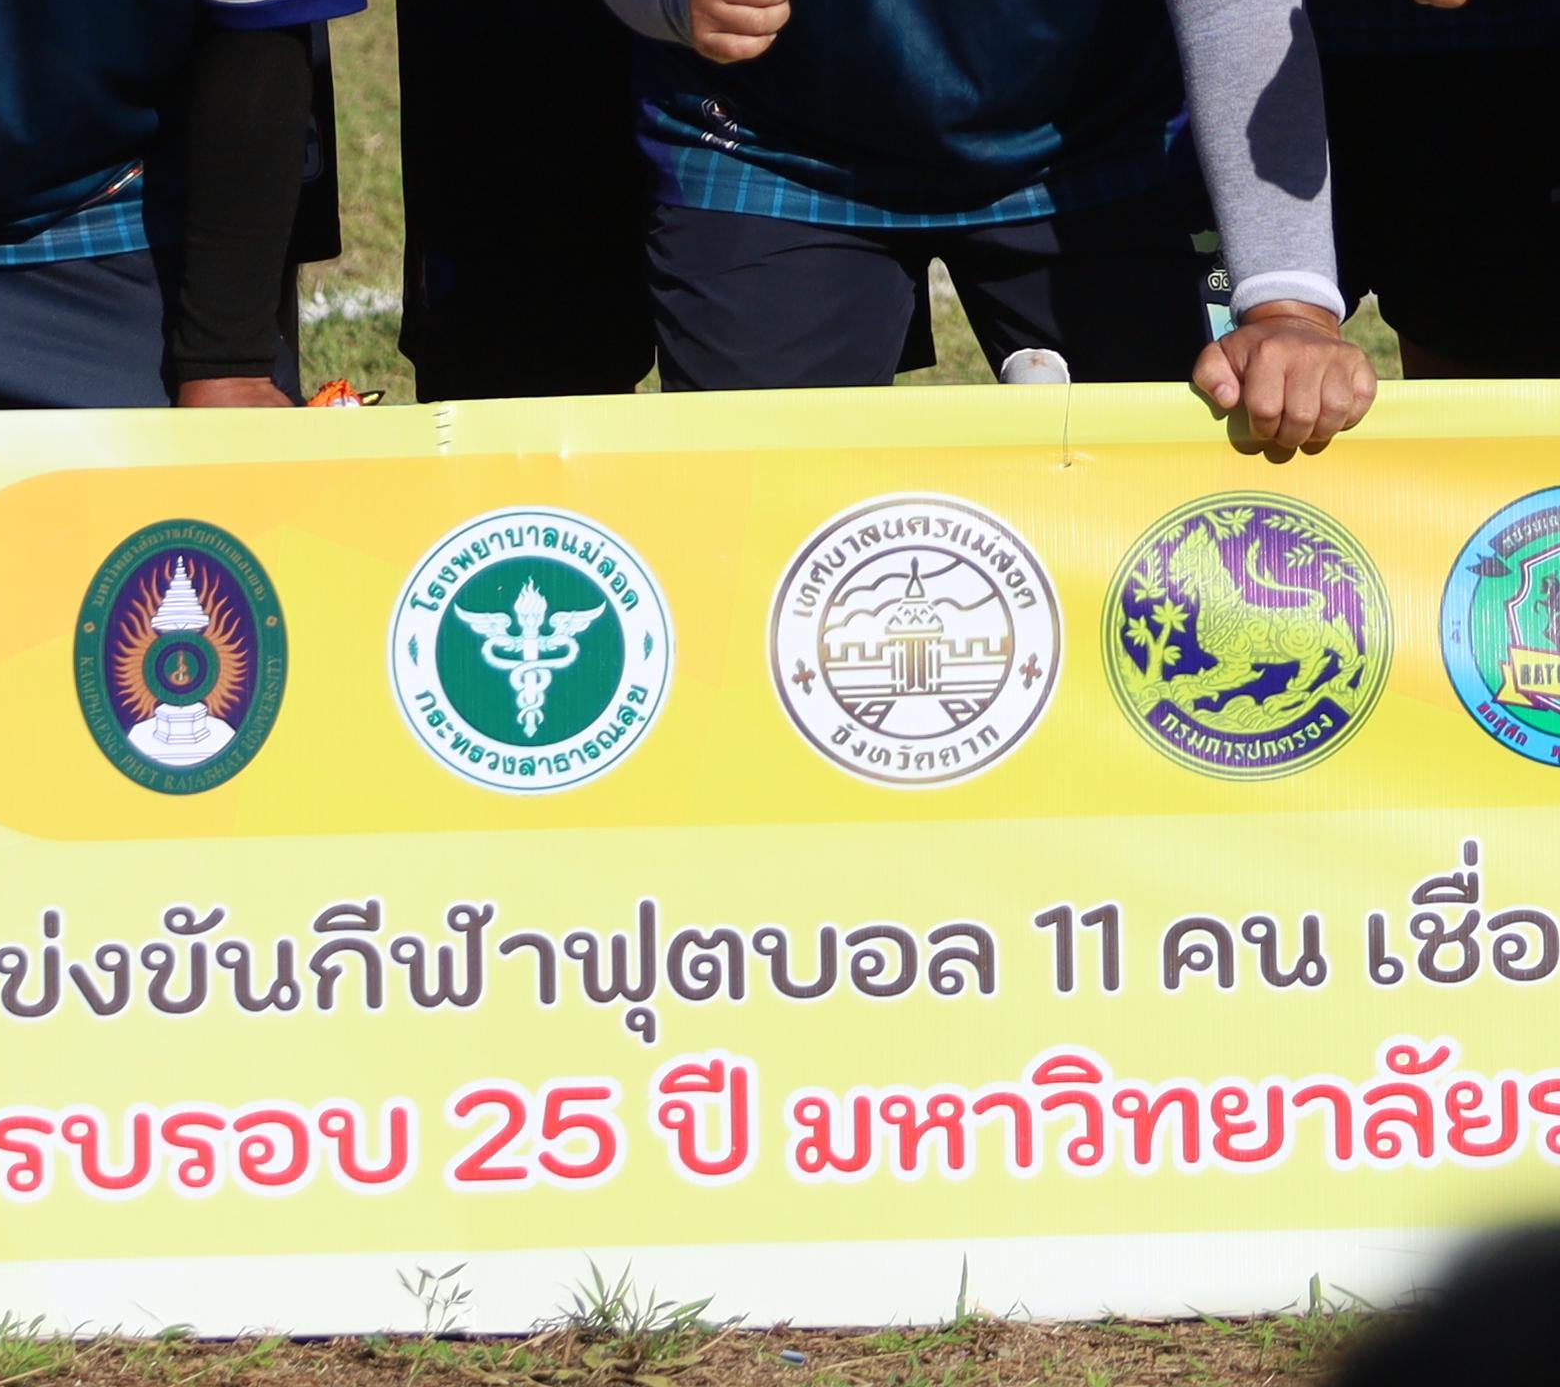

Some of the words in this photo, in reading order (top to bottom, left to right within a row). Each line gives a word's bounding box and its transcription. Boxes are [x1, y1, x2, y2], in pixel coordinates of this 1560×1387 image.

[410, 524, 639, 613] โรงพยาบาลแม่สอด
[792, 515, 1038, 618] เทศบาลนครแม่สอด
[122, 754, 158, 784] PHET
[415, 683, 649, 777] กระทรวงสาธารณสุข
[830, 722, 1001, 772] จังหวัดตาก
[1159, 712, 1335, 761] กรมการปกครอง
[1037, 904, 1121, 993] 11
[1162, 915, 1328, 991] คน
[453, 1086, 617, 1183] 25
[657, 1061, 749, 1177] ปี
